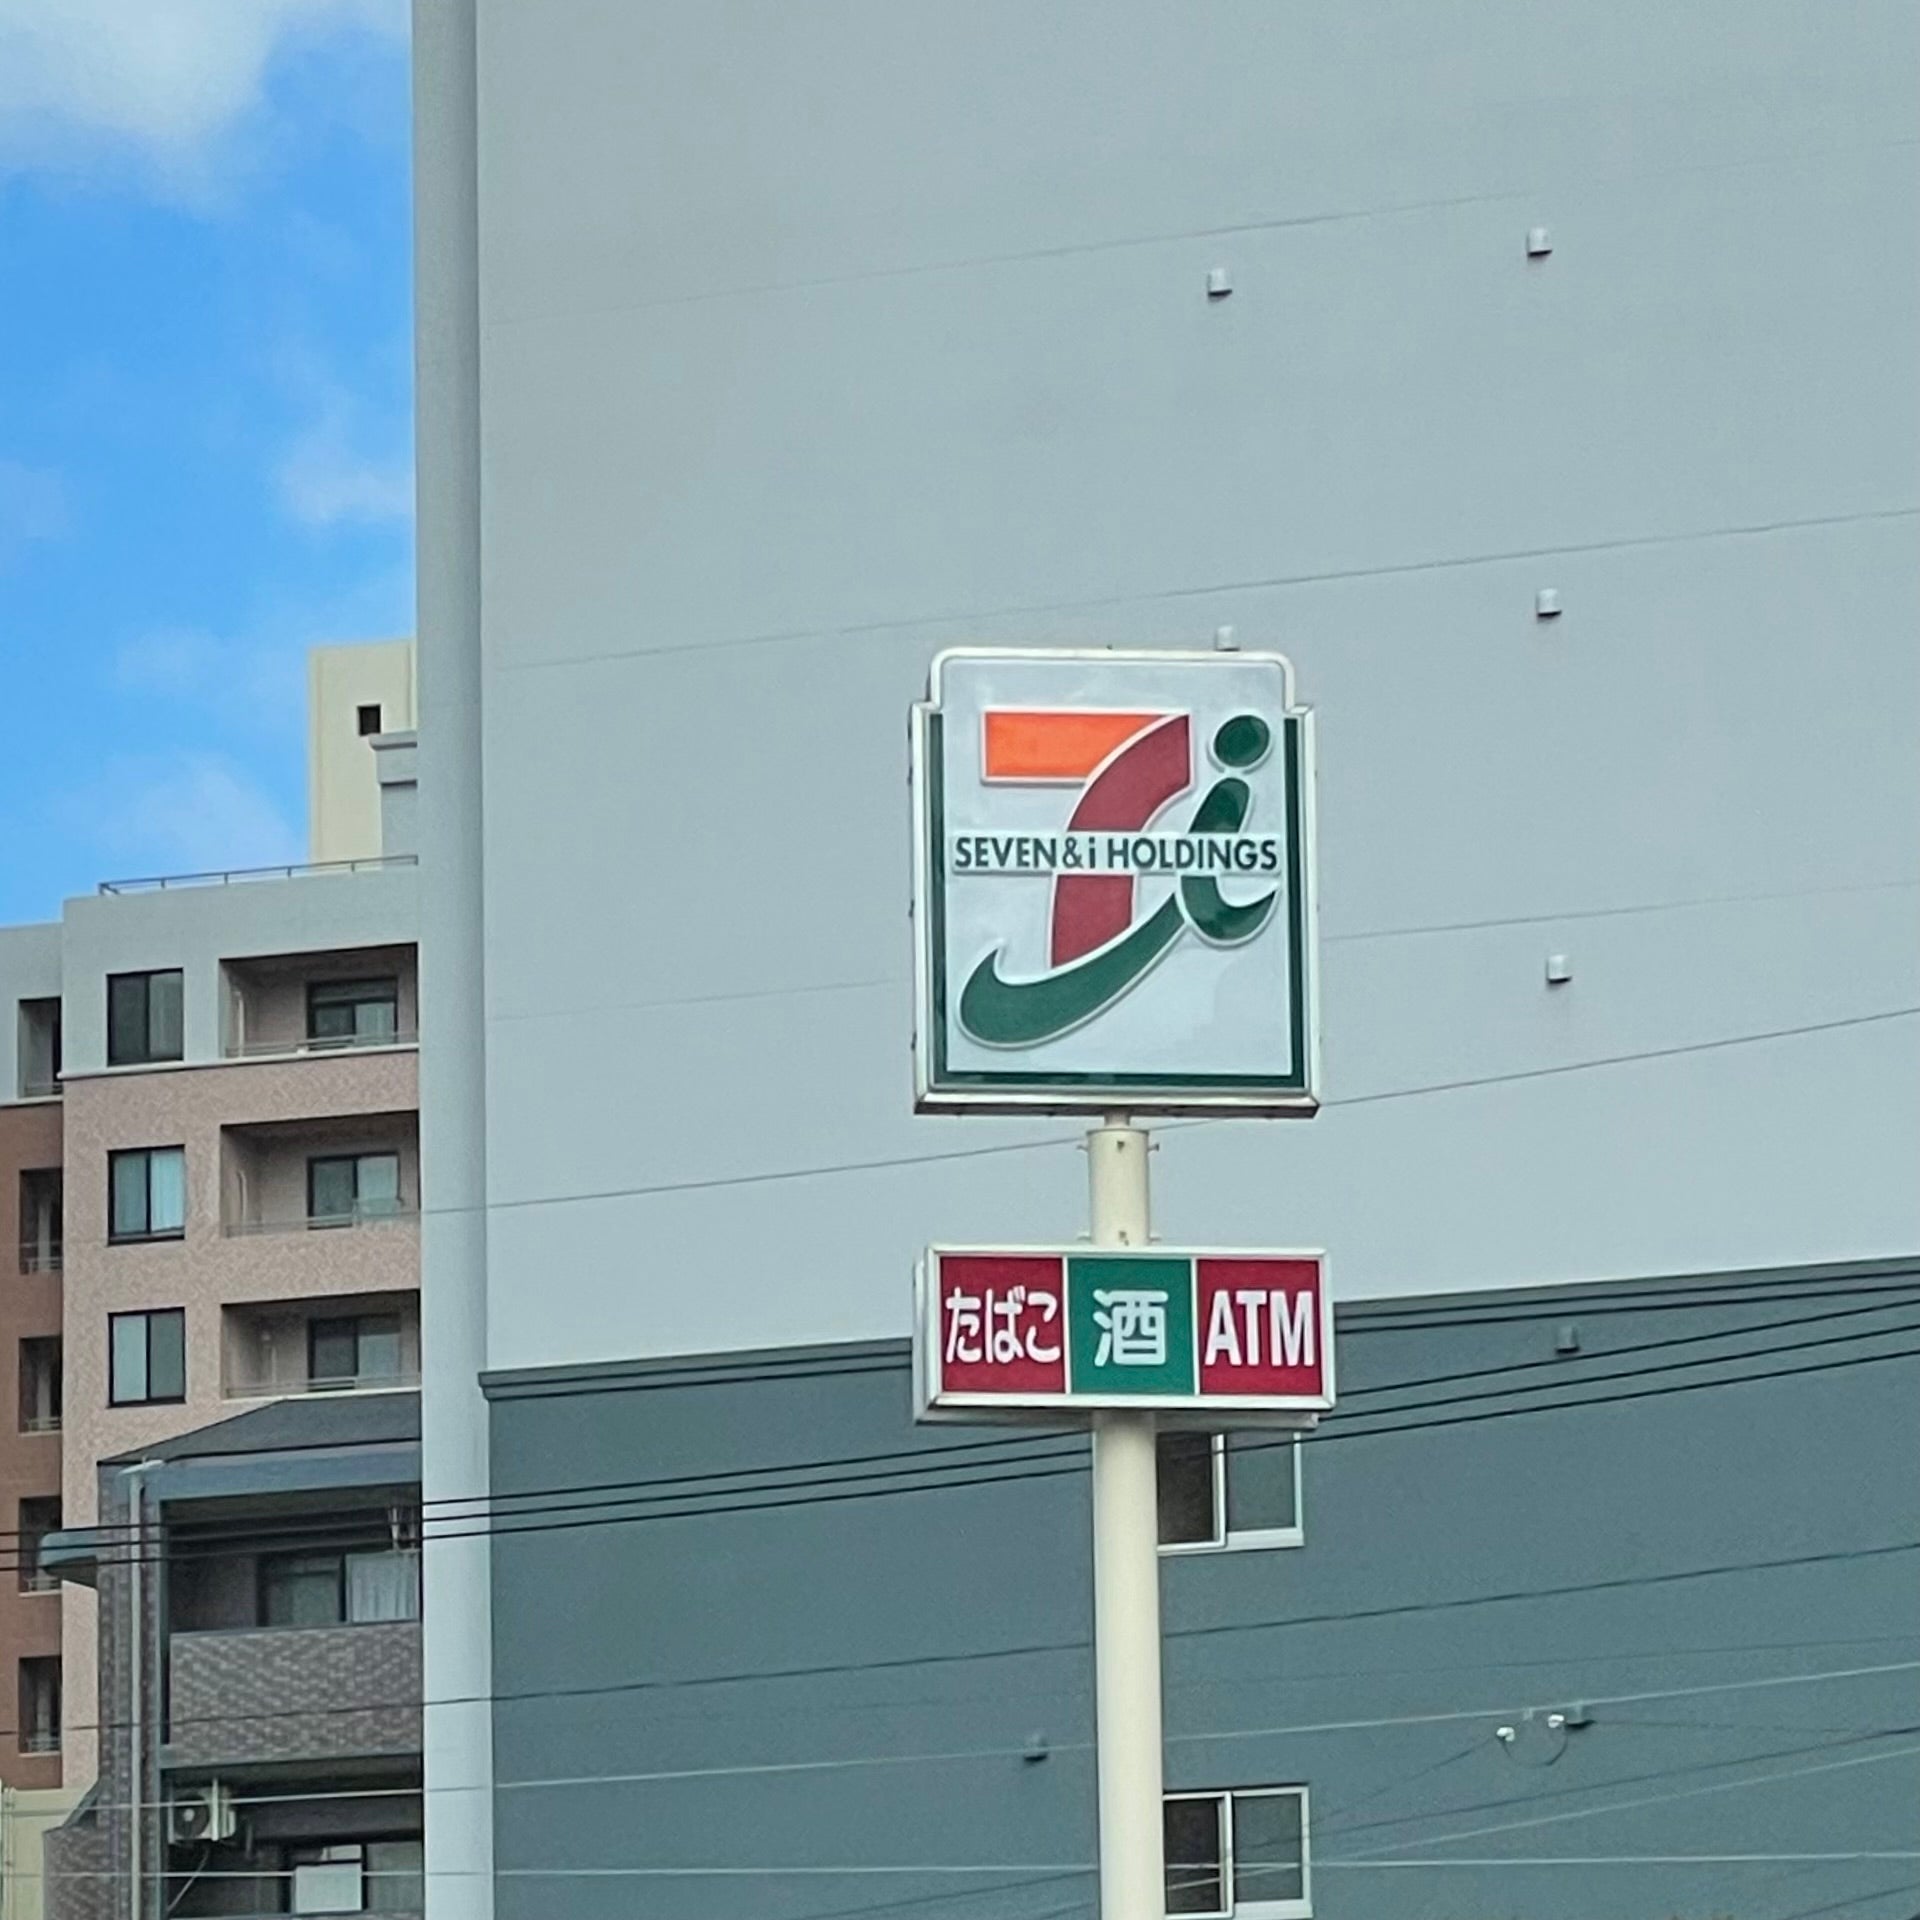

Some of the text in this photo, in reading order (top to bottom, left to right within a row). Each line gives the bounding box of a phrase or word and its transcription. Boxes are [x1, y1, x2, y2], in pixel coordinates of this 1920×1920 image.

[1107, 838, 1277, 870] HOLDINGS
[945, 1284, 1061, 1364] たばこ
[1093, 1289, 1169, 1366] 酒
[1204, 1290, 1315, 1366] ATM
